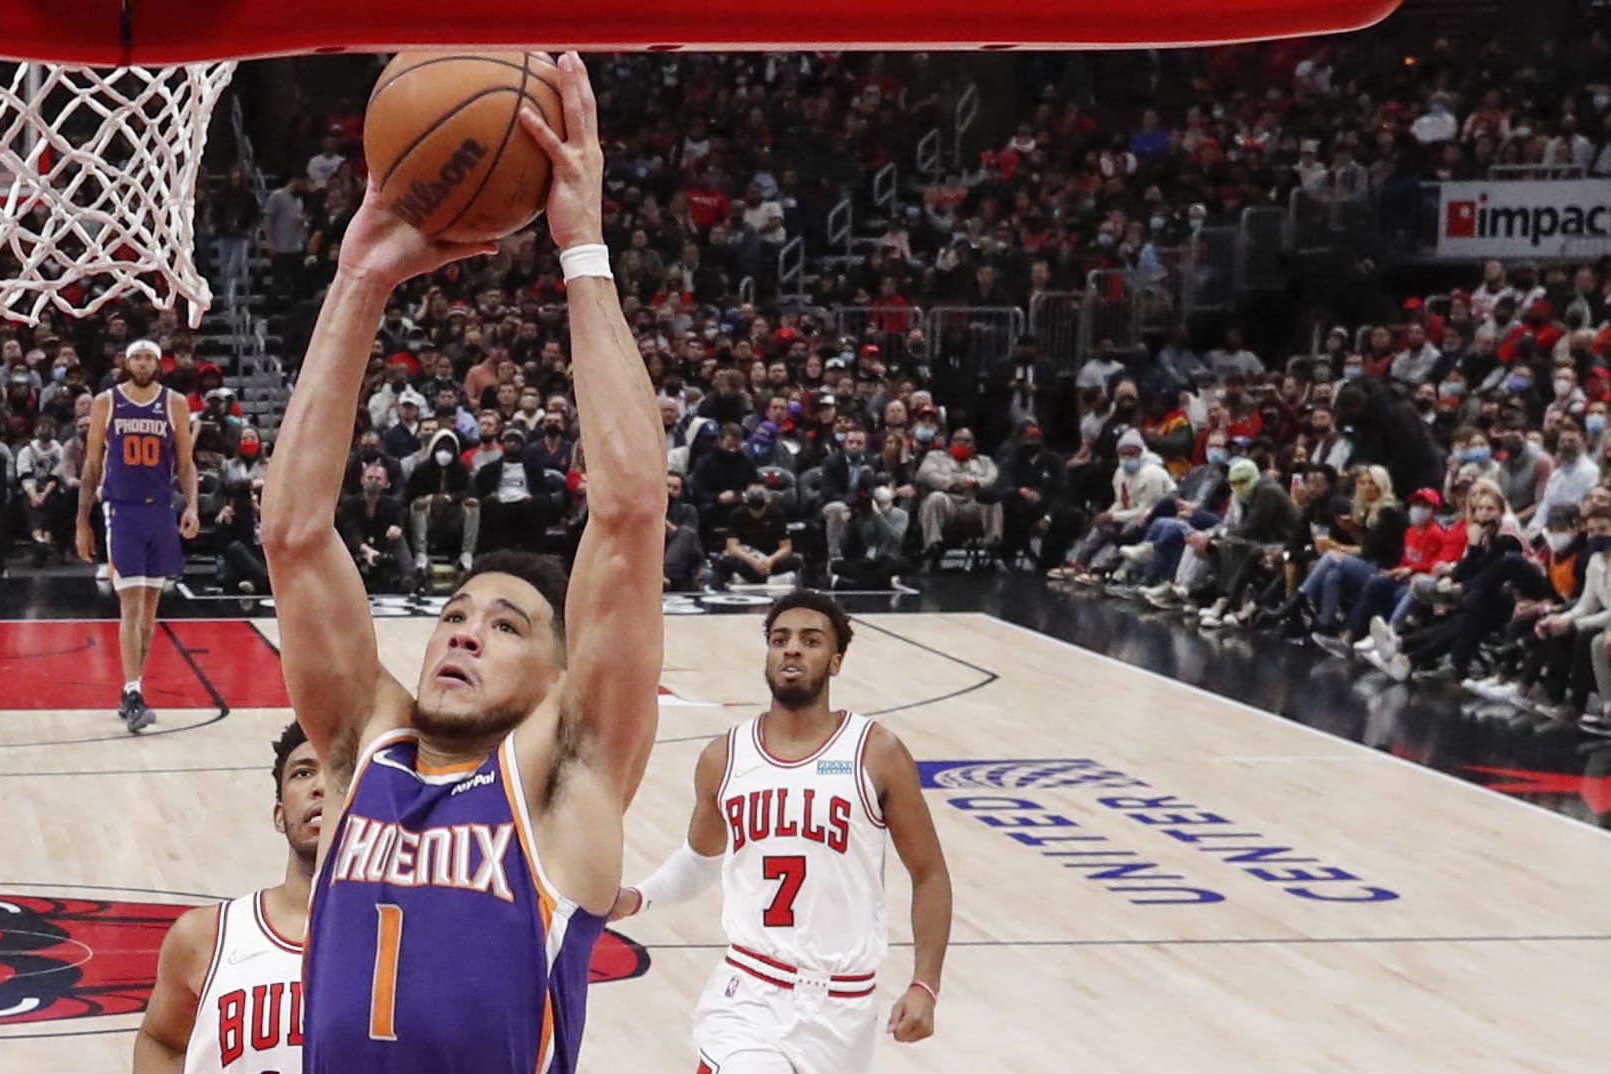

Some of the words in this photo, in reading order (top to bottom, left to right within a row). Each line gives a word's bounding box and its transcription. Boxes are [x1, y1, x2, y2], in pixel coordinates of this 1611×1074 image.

[1478, 192, 1611, 246] impac
[114, 418, 167, 437] PHOENIX
[123, 435, 160, 466] 00
[726, 788, 851, 855] BULLS
[947, 797, 1226, 905] UNITED
[1097, 796, 1400, 902] CENTER
[763, 855, 806, 927] 7
[369, 903, 403, 1041] 1
[218, 982, 304, 1068] BUL
